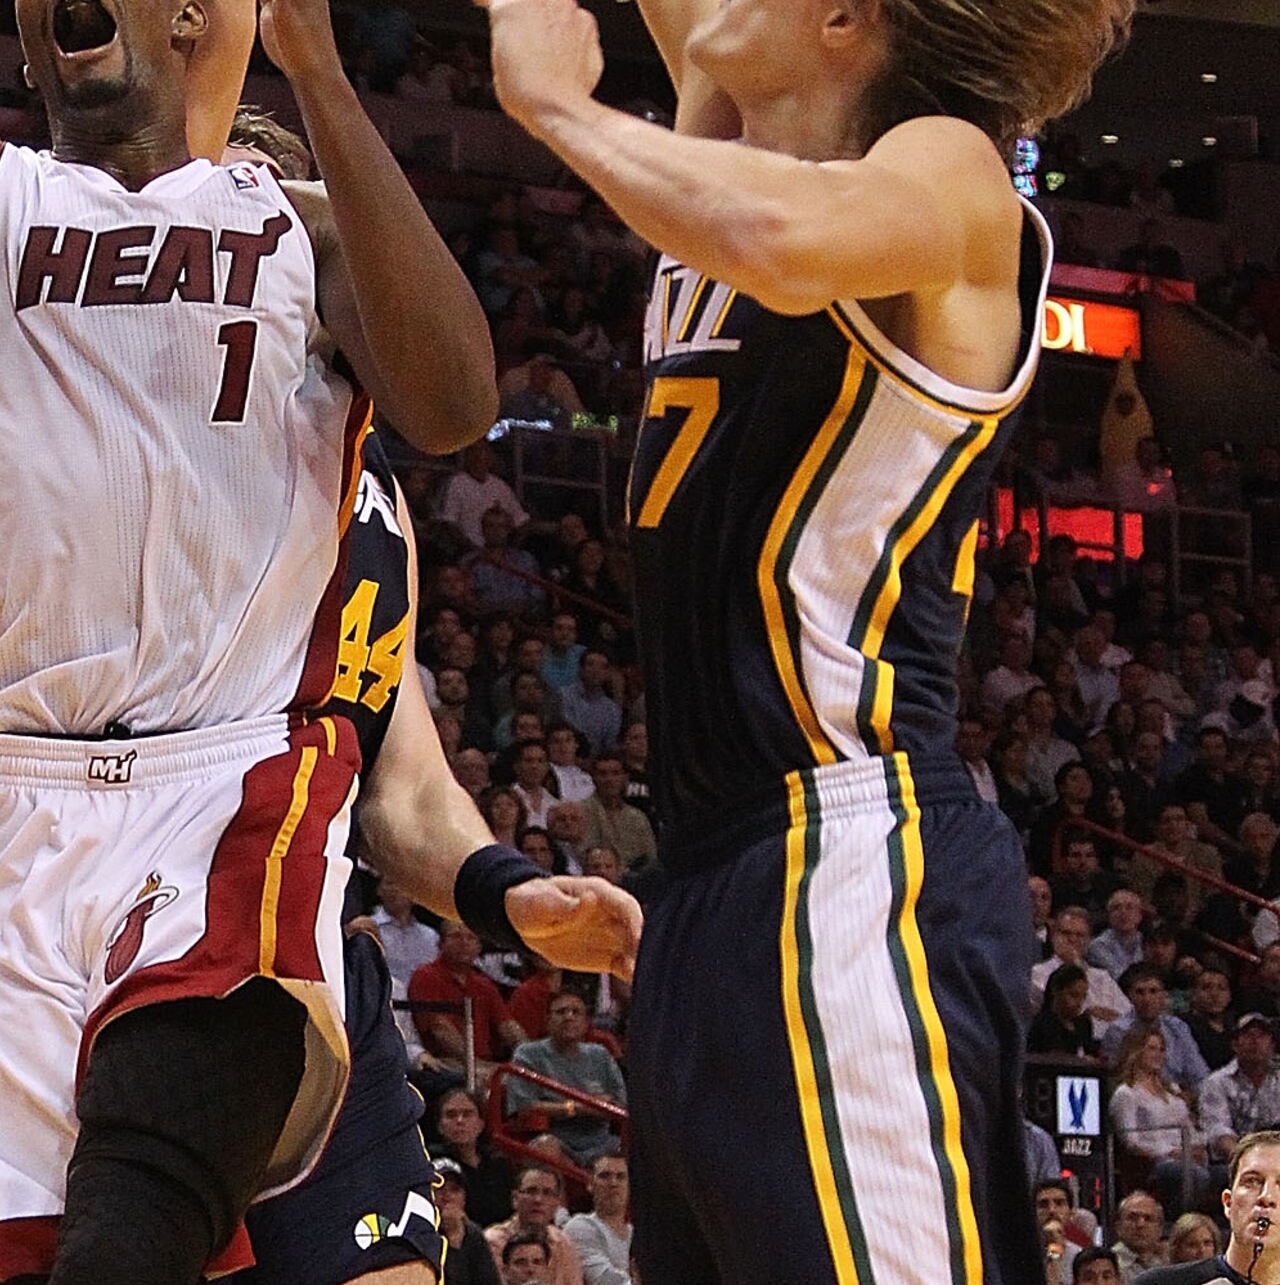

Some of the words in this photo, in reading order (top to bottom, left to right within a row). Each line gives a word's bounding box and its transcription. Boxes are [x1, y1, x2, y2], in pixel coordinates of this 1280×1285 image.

[15, 209, 293, 314] HEAT
[208, 319, 261, 425] 1
[332, 578, 411, 714] 44
[1062, 1138, 1093, 1156] JAZZ
